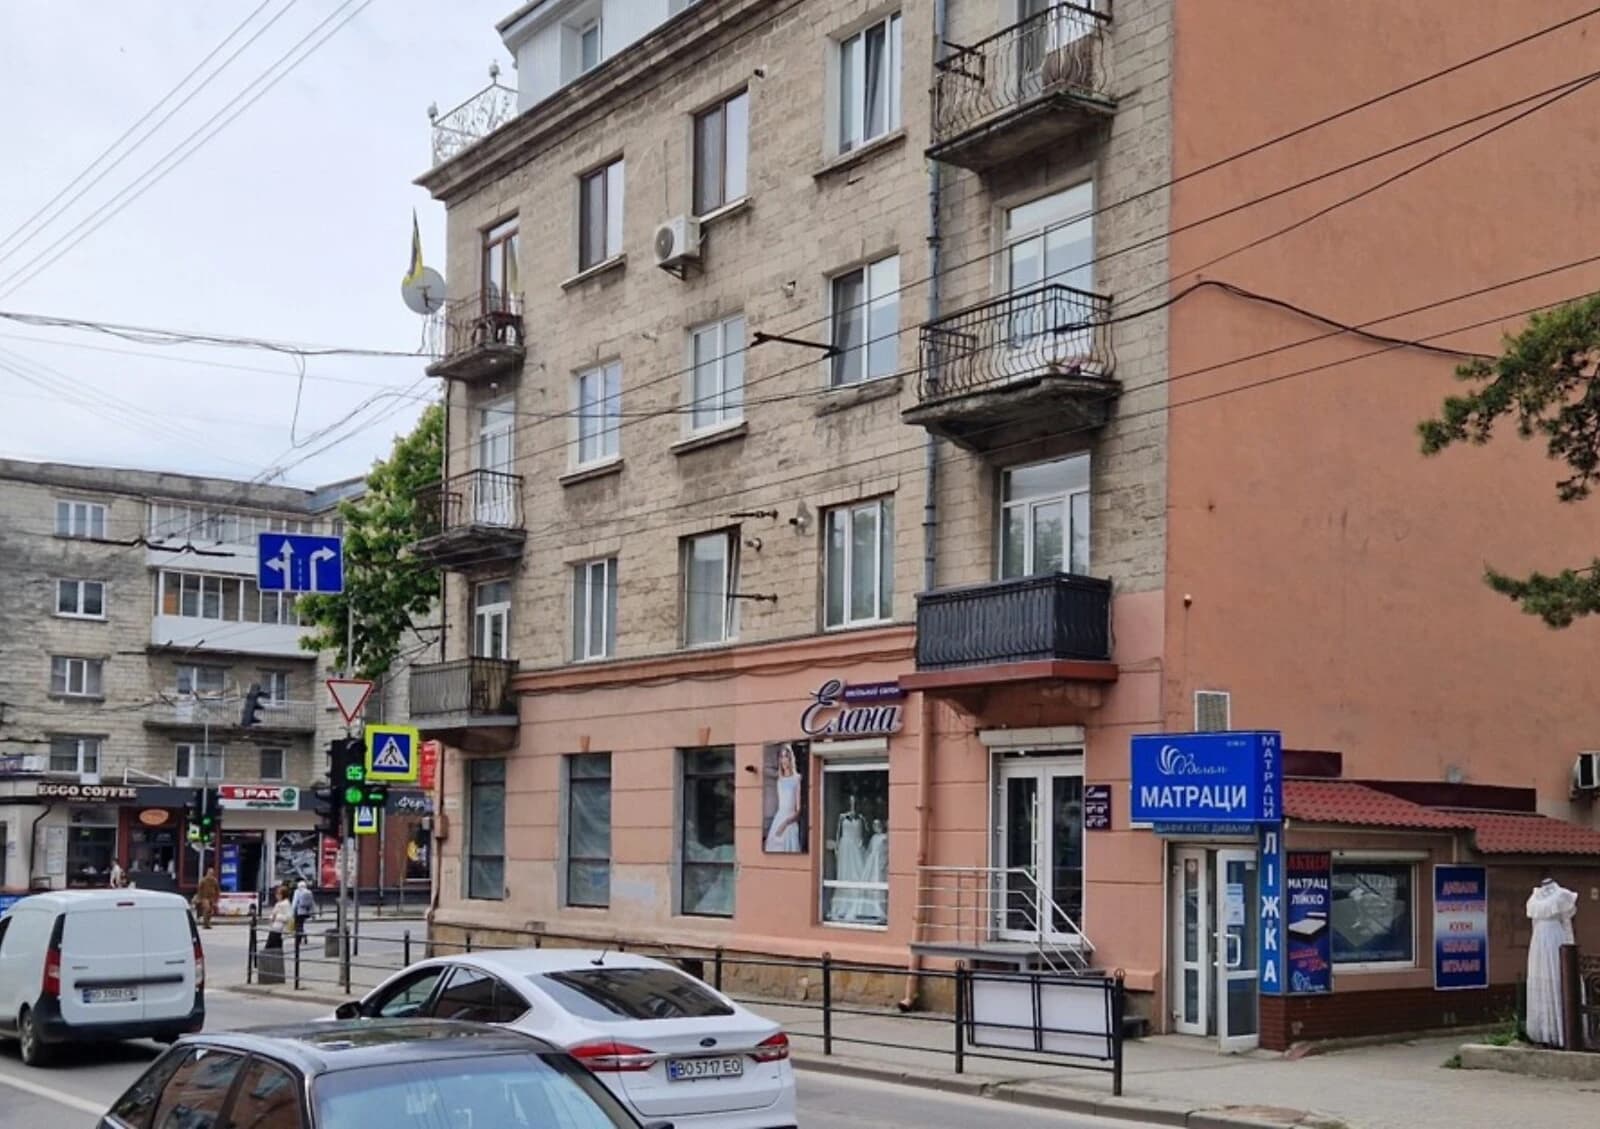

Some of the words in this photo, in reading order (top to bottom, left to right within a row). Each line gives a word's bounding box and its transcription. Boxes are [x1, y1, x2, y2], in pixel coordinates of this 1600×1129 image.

[1261, 735, 1275, 818] МАТРАЦИ
[81, 785, 137, 797] COFFEE
[234, 788, 281, 799] SPAR
[1140, 785, 1247, 812] МАТРАЦИ
[1287, 878, 1329, 890] МАТРАЦ
[1262, 832, 1280, 983] ЛІЖКА
[695, 1060, 720, 1074] 5717
